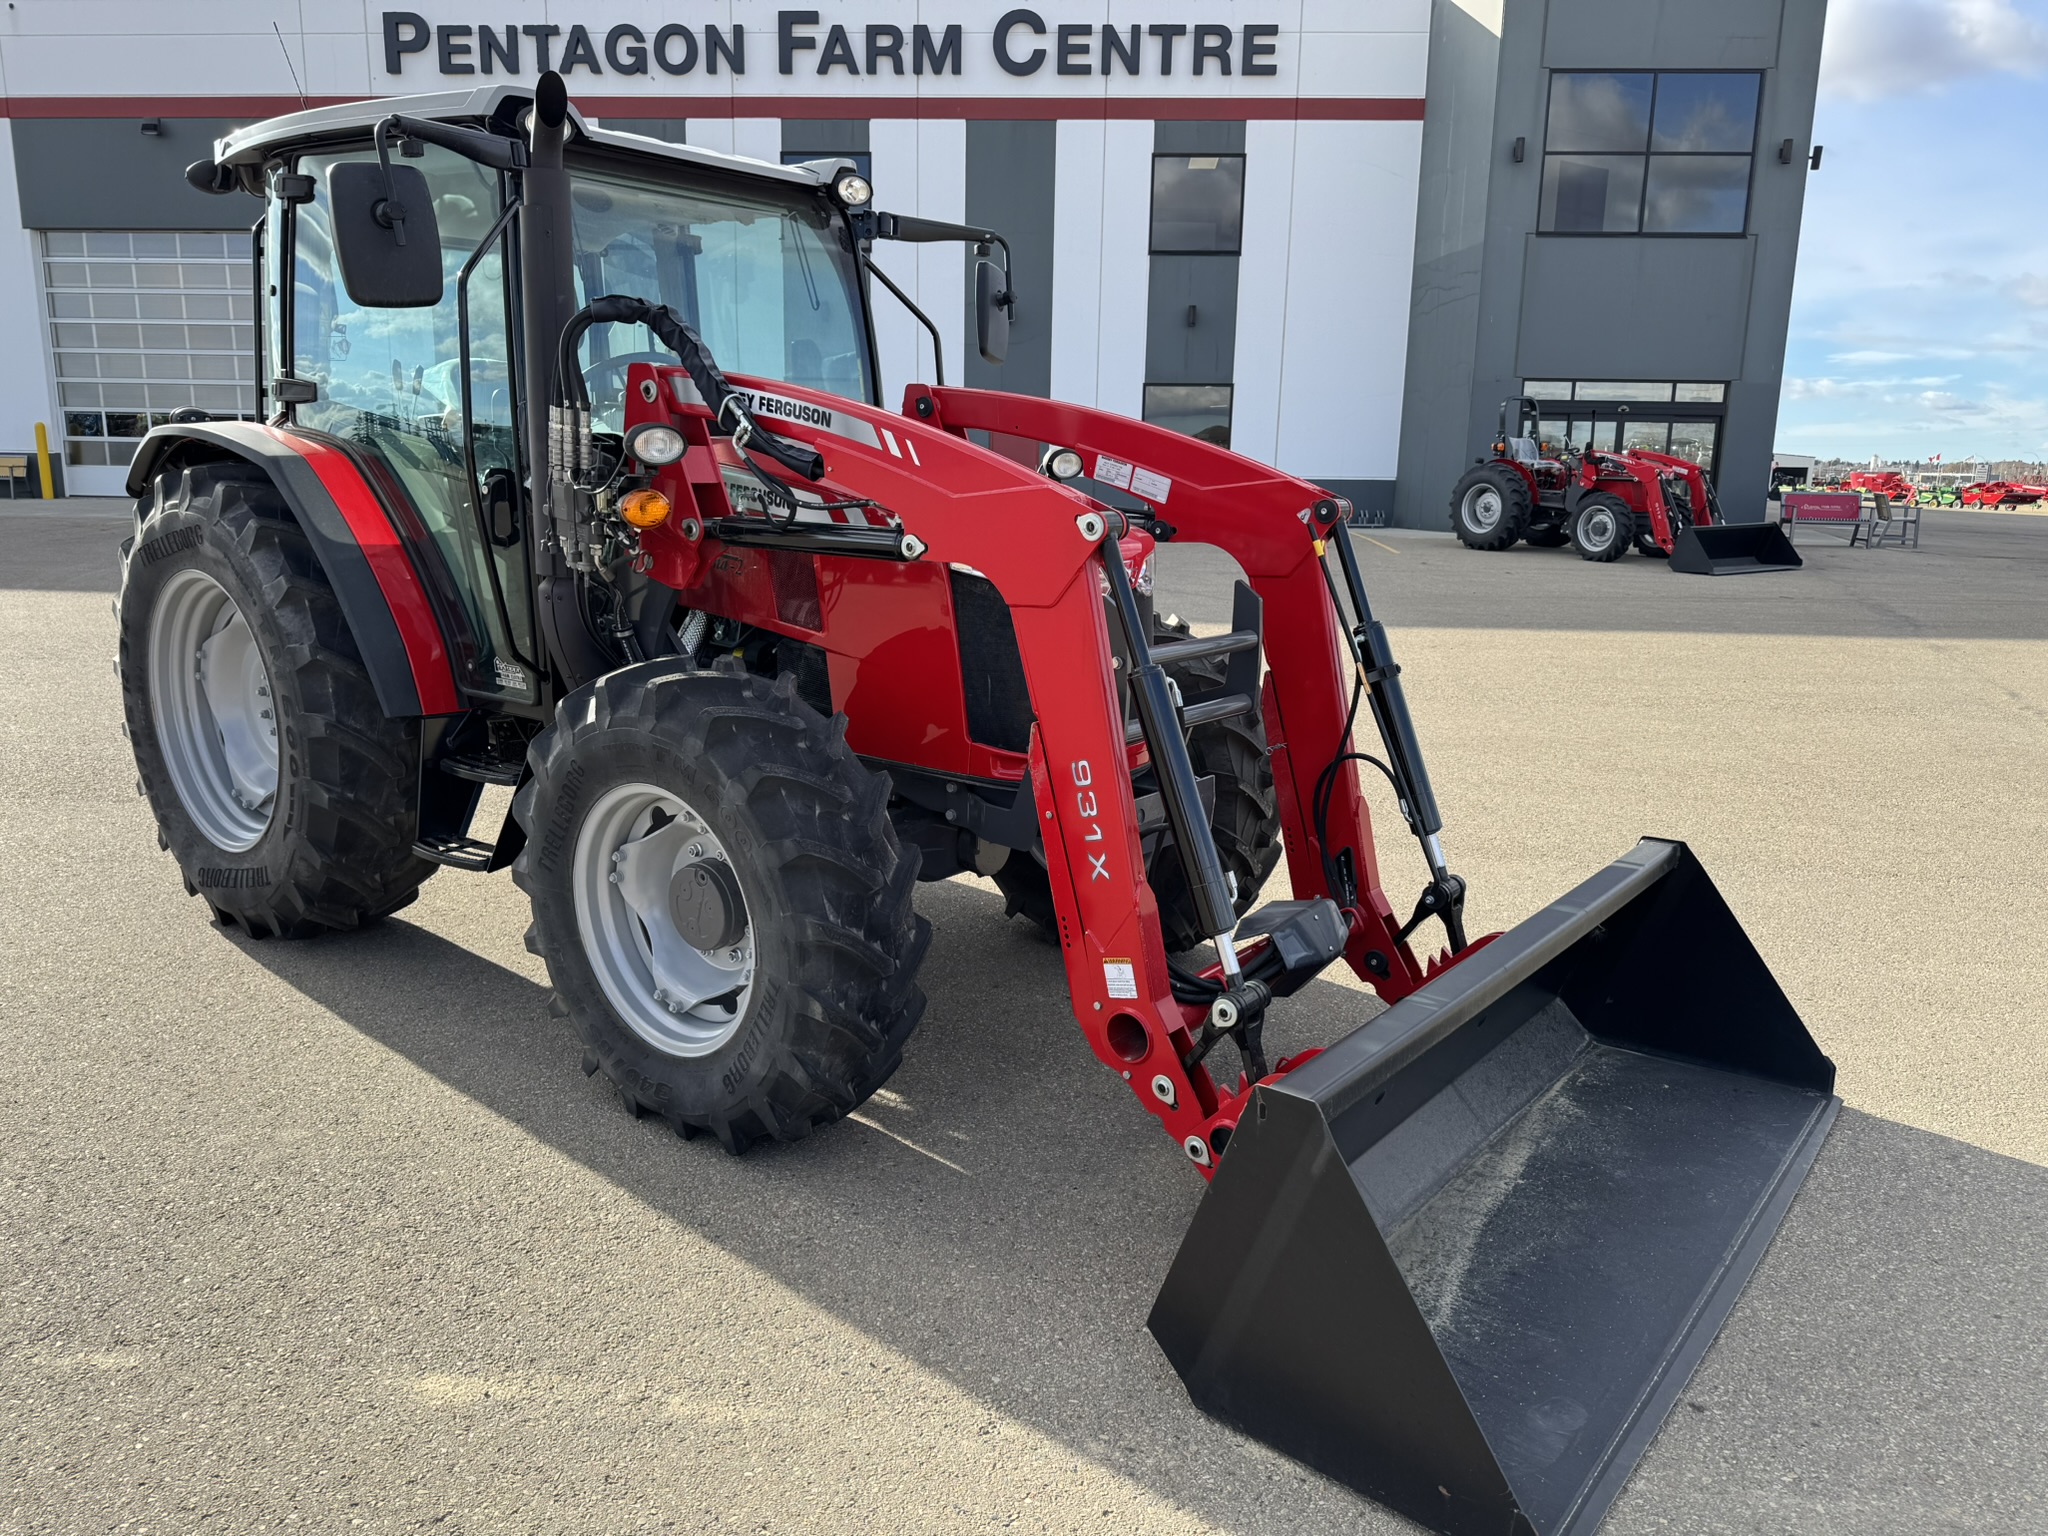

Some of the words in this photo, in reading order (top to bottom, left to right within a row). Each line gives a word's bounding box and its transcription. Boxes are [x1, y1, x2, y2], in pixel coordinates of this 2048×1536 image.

[382, 11, 745, 76] PENTAGON
[777, 10, 964, 76] FARM
[992, 9, 1279, 77] CENTRE
[758, 395, 832, 428] FERGUSON
[138, 523, 205, 568] TRELLEBORG
[538, 759, 586, 873] TRELLEBORG
[1071, 759, 1111, 882] 931X
[197, 865, 273, 890] TRELLEBORG
[722, 983, 782, 1094] TRELLEBORG
